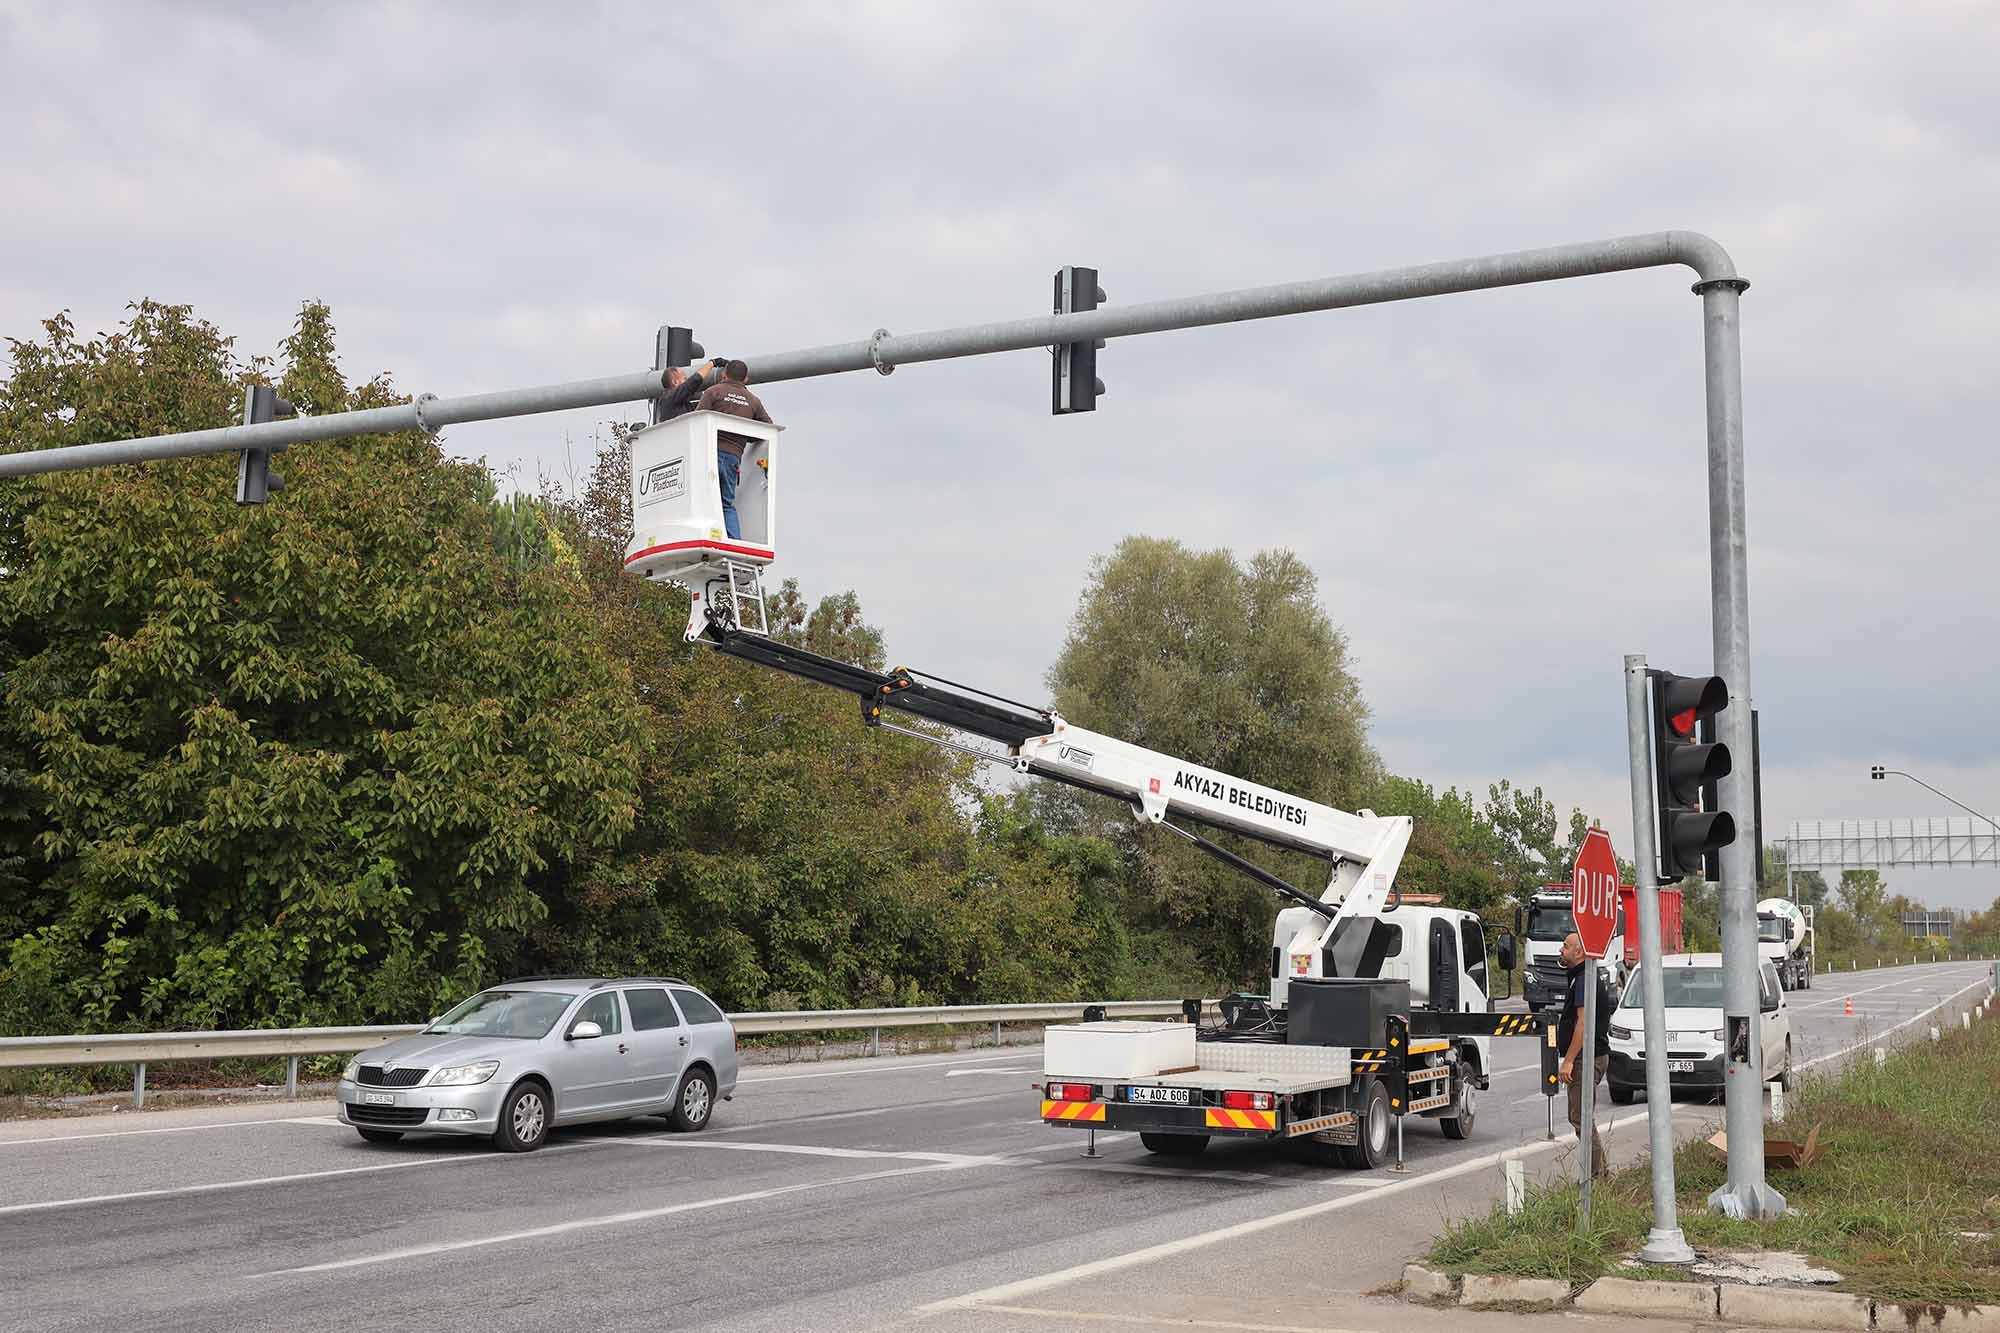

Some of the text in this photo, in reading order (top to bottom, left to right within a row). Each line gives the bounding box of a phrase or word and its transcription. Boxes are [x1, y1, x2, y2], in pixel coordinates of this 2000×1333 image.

[1174, 771, 1307, 826] AKYAZI BELEDİYESİ
[1577, 868, 1615, 920] DUR
[1134, 1089, 1188, 1101] 54 AOZ 606
